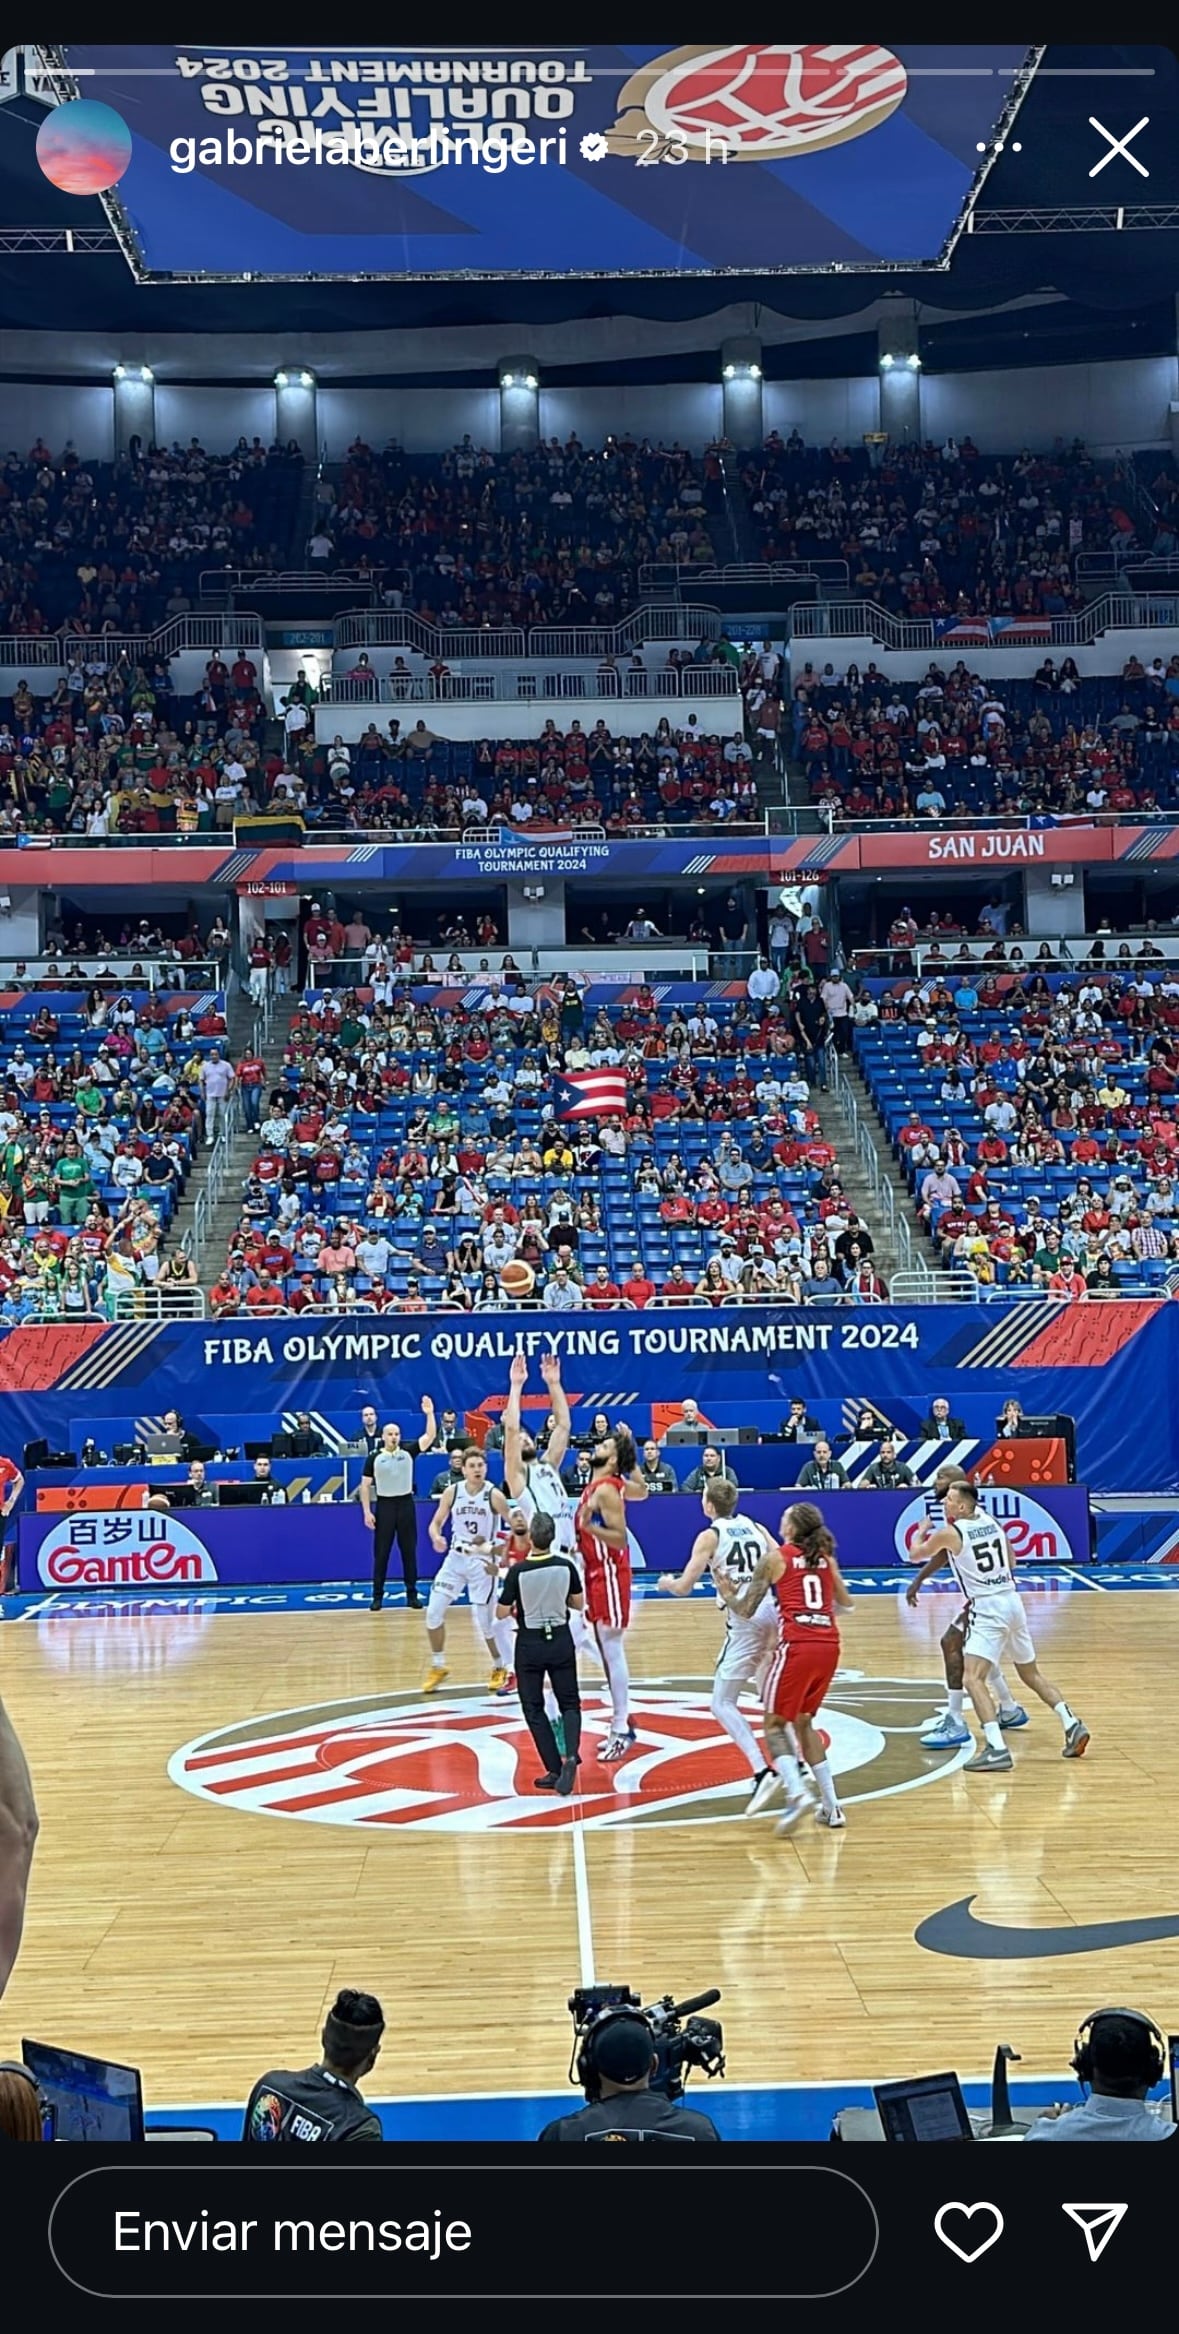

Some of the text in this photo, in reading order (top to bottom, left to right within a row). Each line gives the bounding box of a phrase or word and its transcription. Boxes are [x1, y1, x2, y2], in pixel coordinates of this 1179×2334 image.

[174, 56, 593, 83] TOURNAMENT 2024
[200, 82, 575, 119] QUALIFYING
[455, 845, 610, 860] FIBA OLYMPIC QUALIFYING
[928, 834, 1045, 859] SAN JUAN
[478, 859, 587, 872] TOURNAMENT 2024
[780, 869, 820, 881] 101-126
[247, 881, 287, 894] 102-101
[203, 1322, 920, 1365] FIBA OLYMPIC QUALIFYING TOURNAMENT 2024
[69, 1517, 167, 1545] 百岁山
[464, 1520, 479, 1535] 13
[726, 1541, 761, 1572] 40
[972, 1537, 1006, 1573] 51
[802, 1574, 823, 1610] 0
[290, 2114, 322, 2141] FIBA
